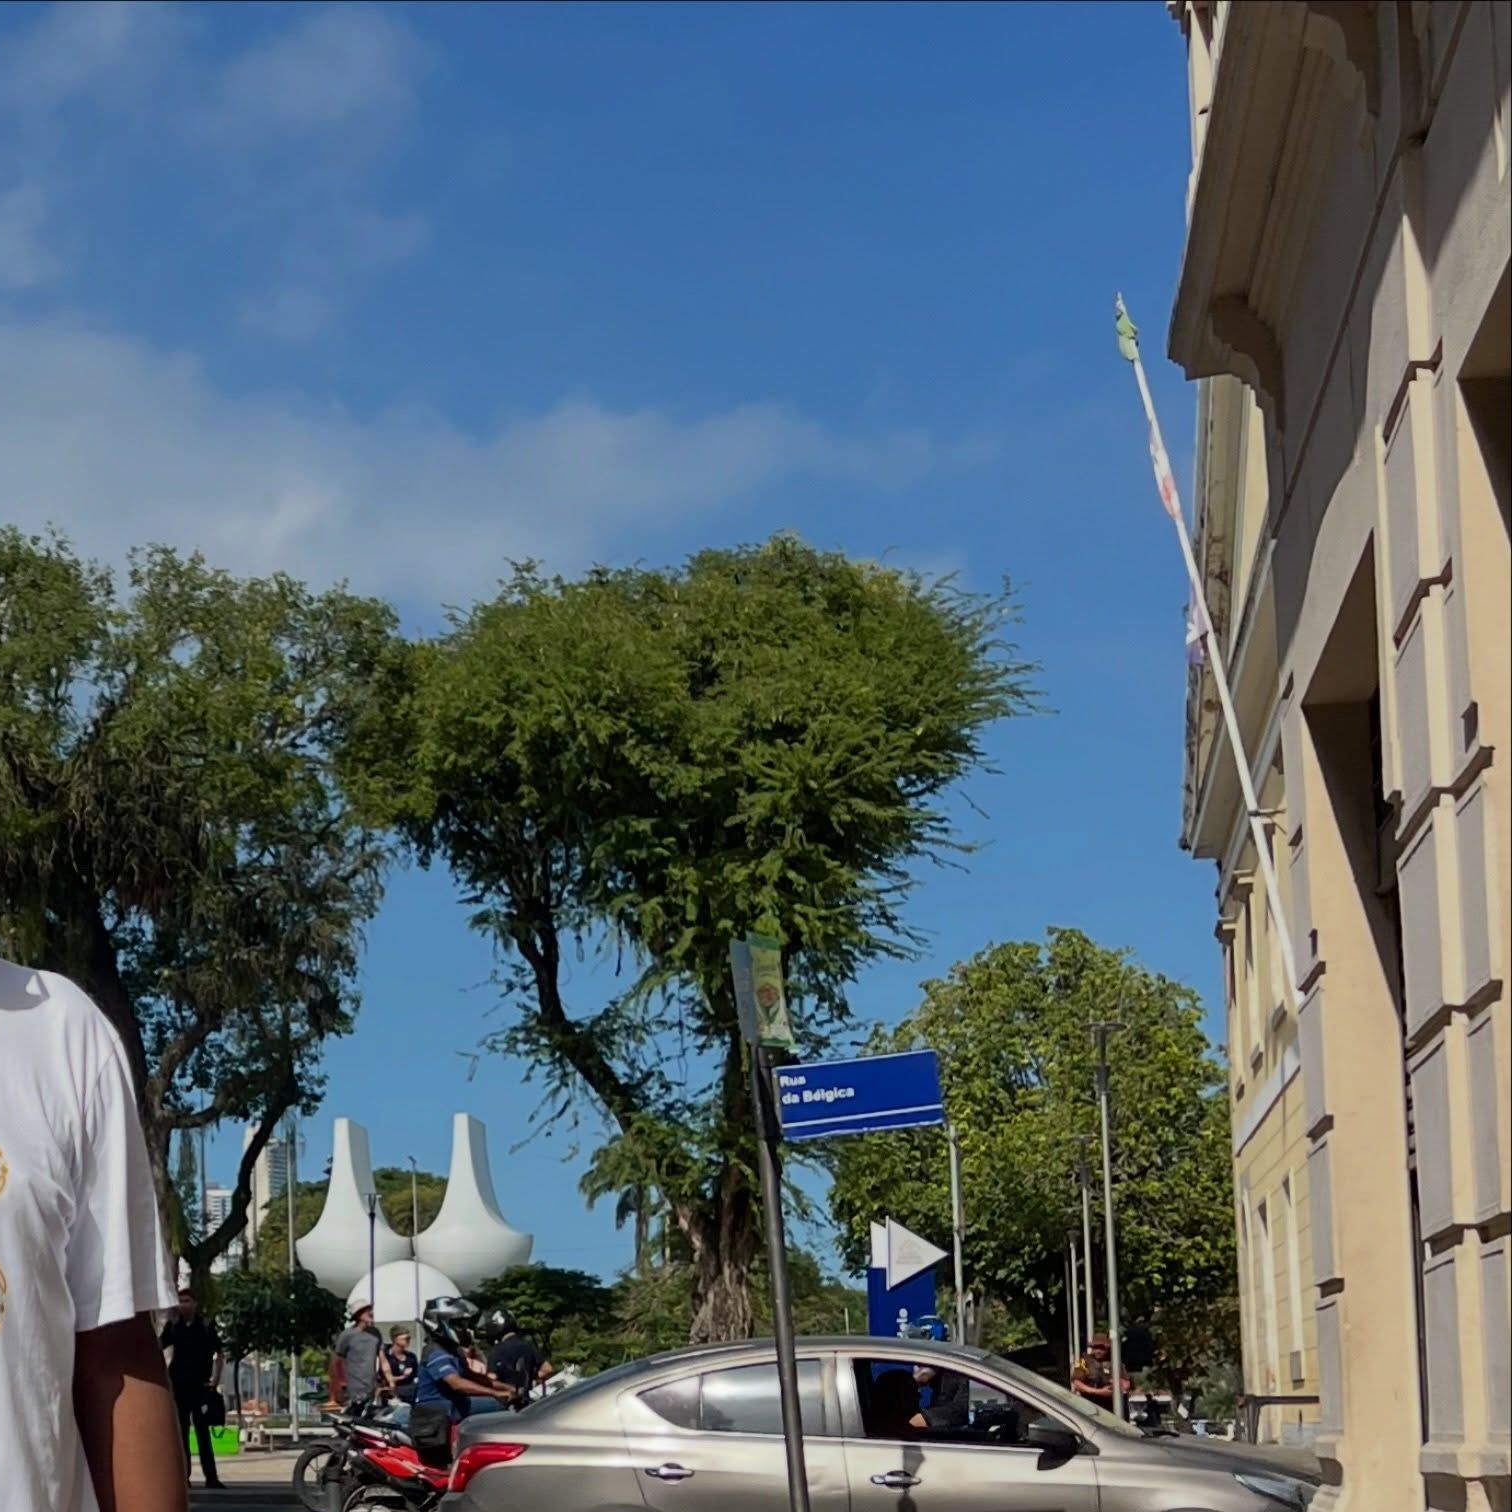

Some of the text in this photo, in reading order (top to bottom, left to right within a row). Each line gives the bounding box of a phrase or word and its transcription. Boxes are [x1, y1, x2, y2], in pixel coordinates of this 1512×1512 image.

[779, 1075, 806, 1088] Rua
[782, 1087, 855, 1105] da Bélgica
